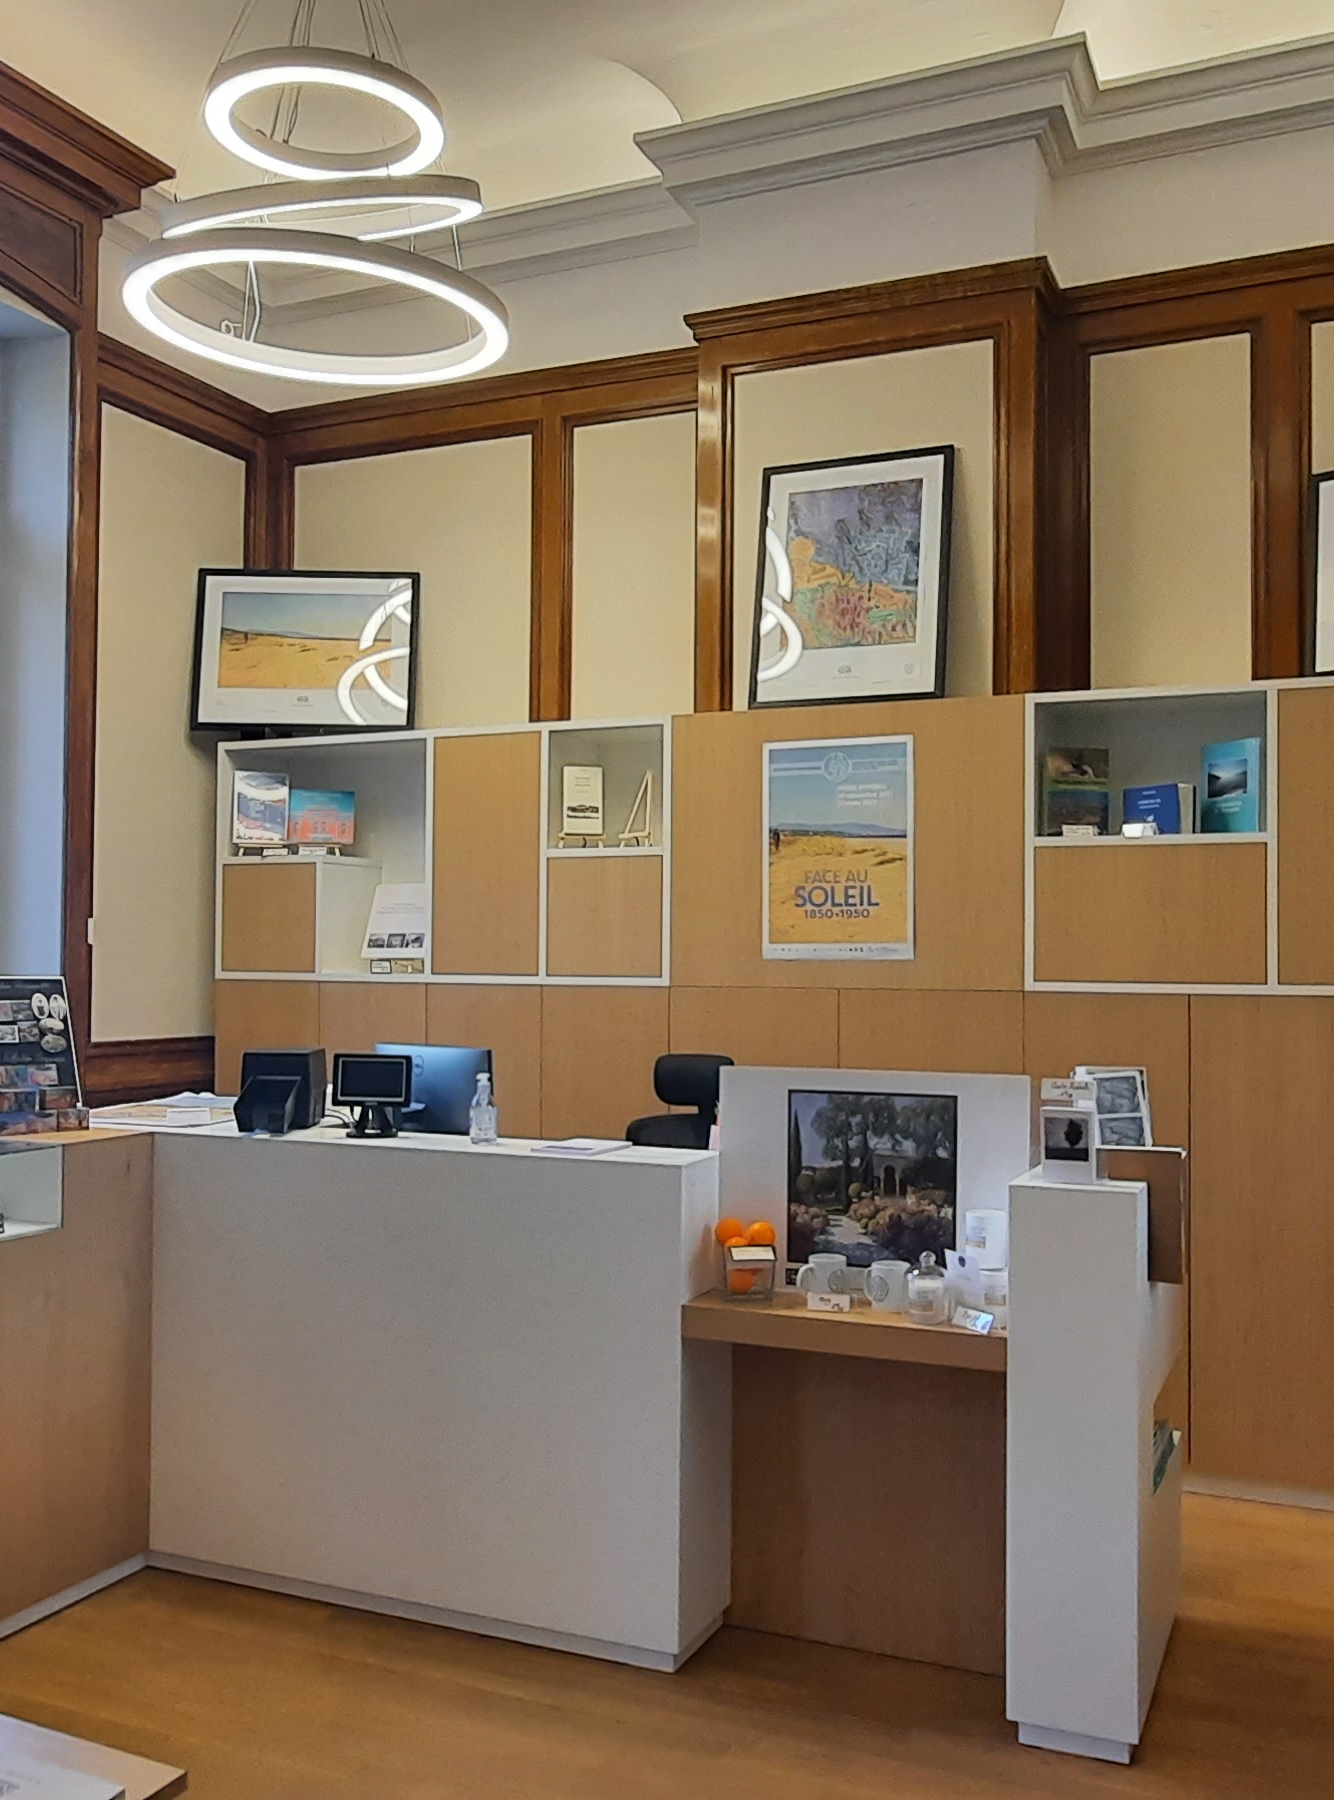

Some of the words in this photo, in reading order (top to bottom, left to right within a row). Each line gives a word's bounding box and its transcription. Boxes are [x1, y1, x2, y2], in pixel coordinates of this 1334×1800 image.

[804, 870, 841, 884] FACE
[845, 869, 868, 883] AU
[795, 885, 880, 907] SOLEIL
